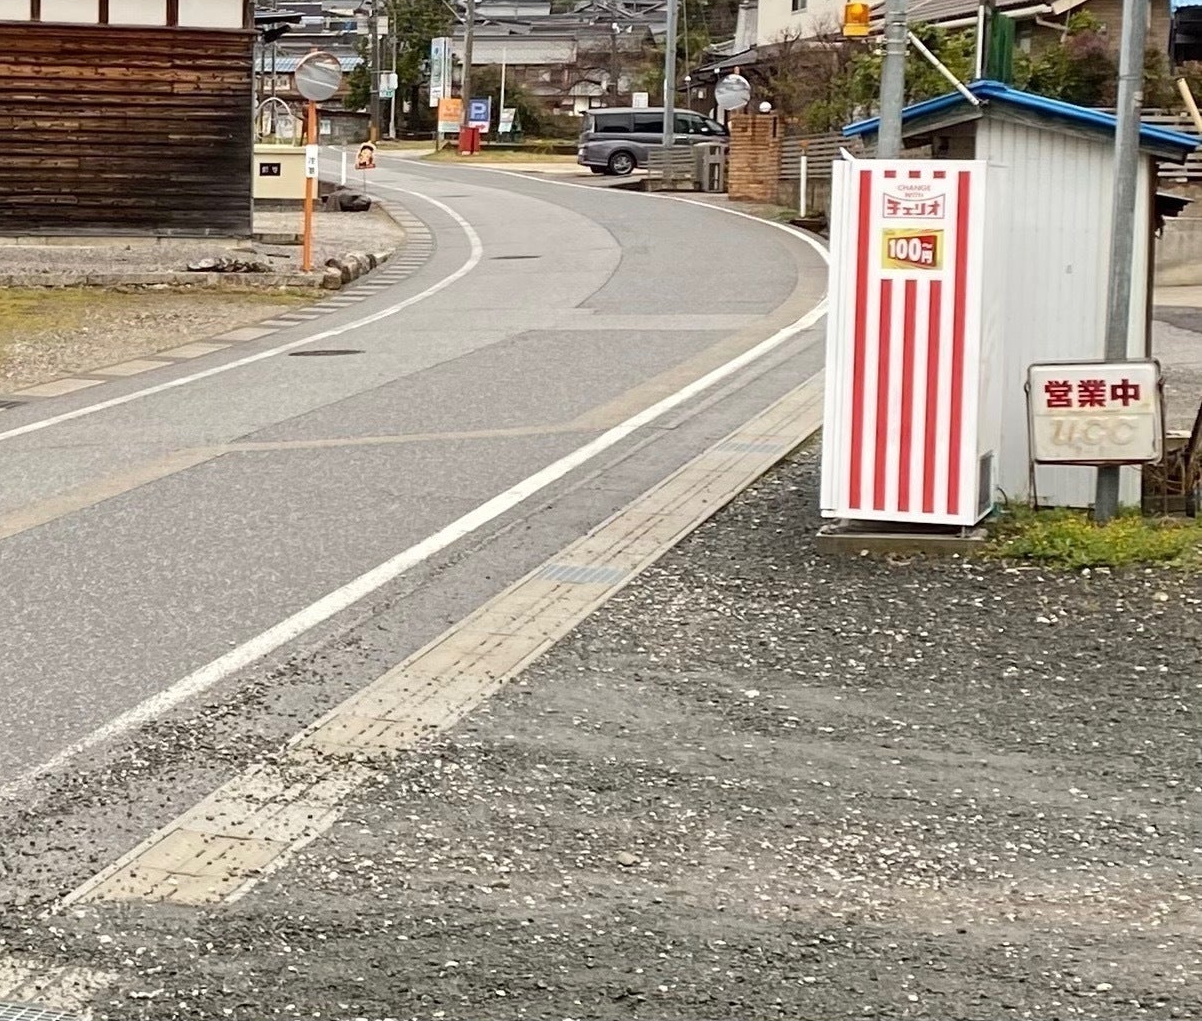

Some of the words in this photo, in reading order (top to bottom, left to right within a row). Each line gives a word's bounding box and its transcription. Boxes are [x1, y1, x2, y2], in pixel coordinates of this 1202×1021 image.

[470, 102, 487, 120] P
[897, 184, 931, 192] CHANGE
[886, 198, 940, 216] チェリオ
[1044, 378, 1140, 408] 営業中
